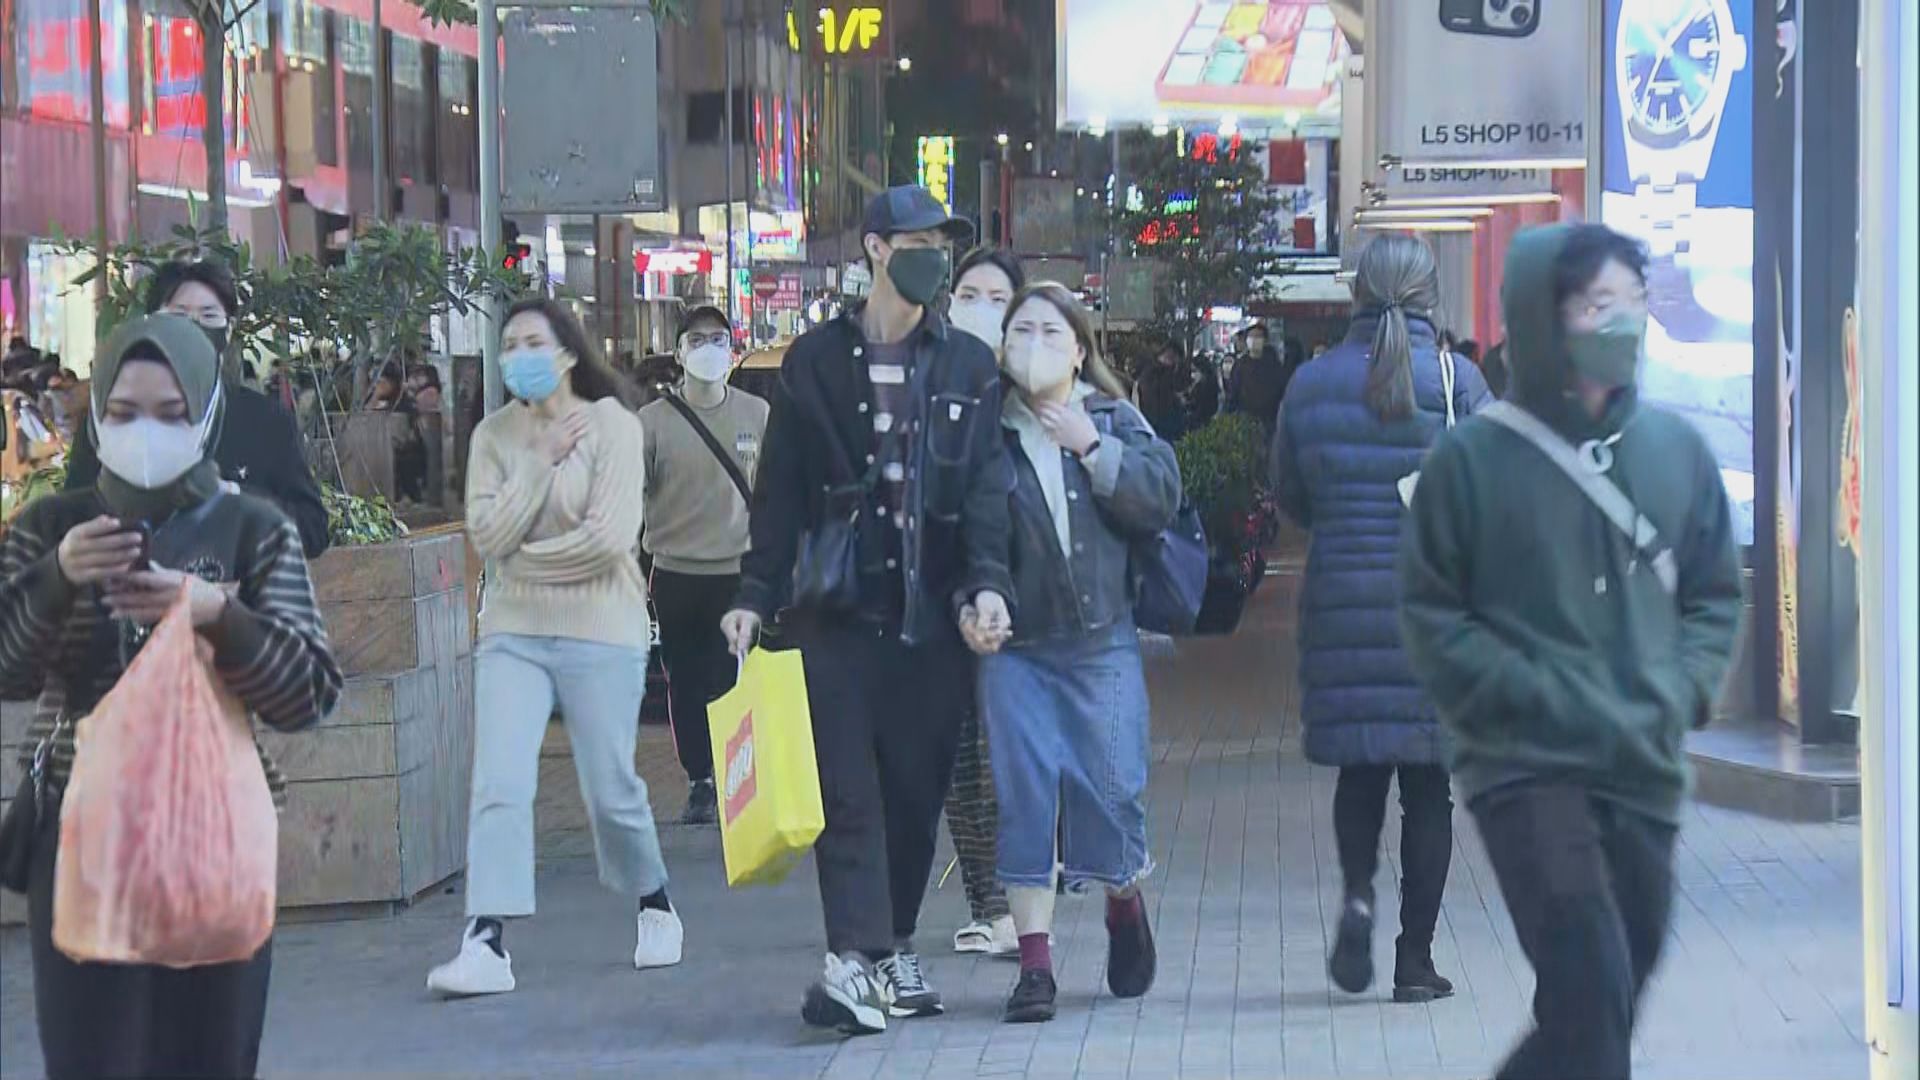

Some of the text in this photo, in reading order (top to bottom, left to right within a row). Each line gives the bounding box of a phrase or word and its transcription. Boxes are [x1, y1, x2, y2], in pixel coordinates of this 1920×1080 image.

[823, 8, 882, 53] 1/F
[1421, 121, 1584, 144] L5 SHOP 10-11
[1403, 167, 1426, 183] L5
[1430, 167, 1485, 182] SHOP
